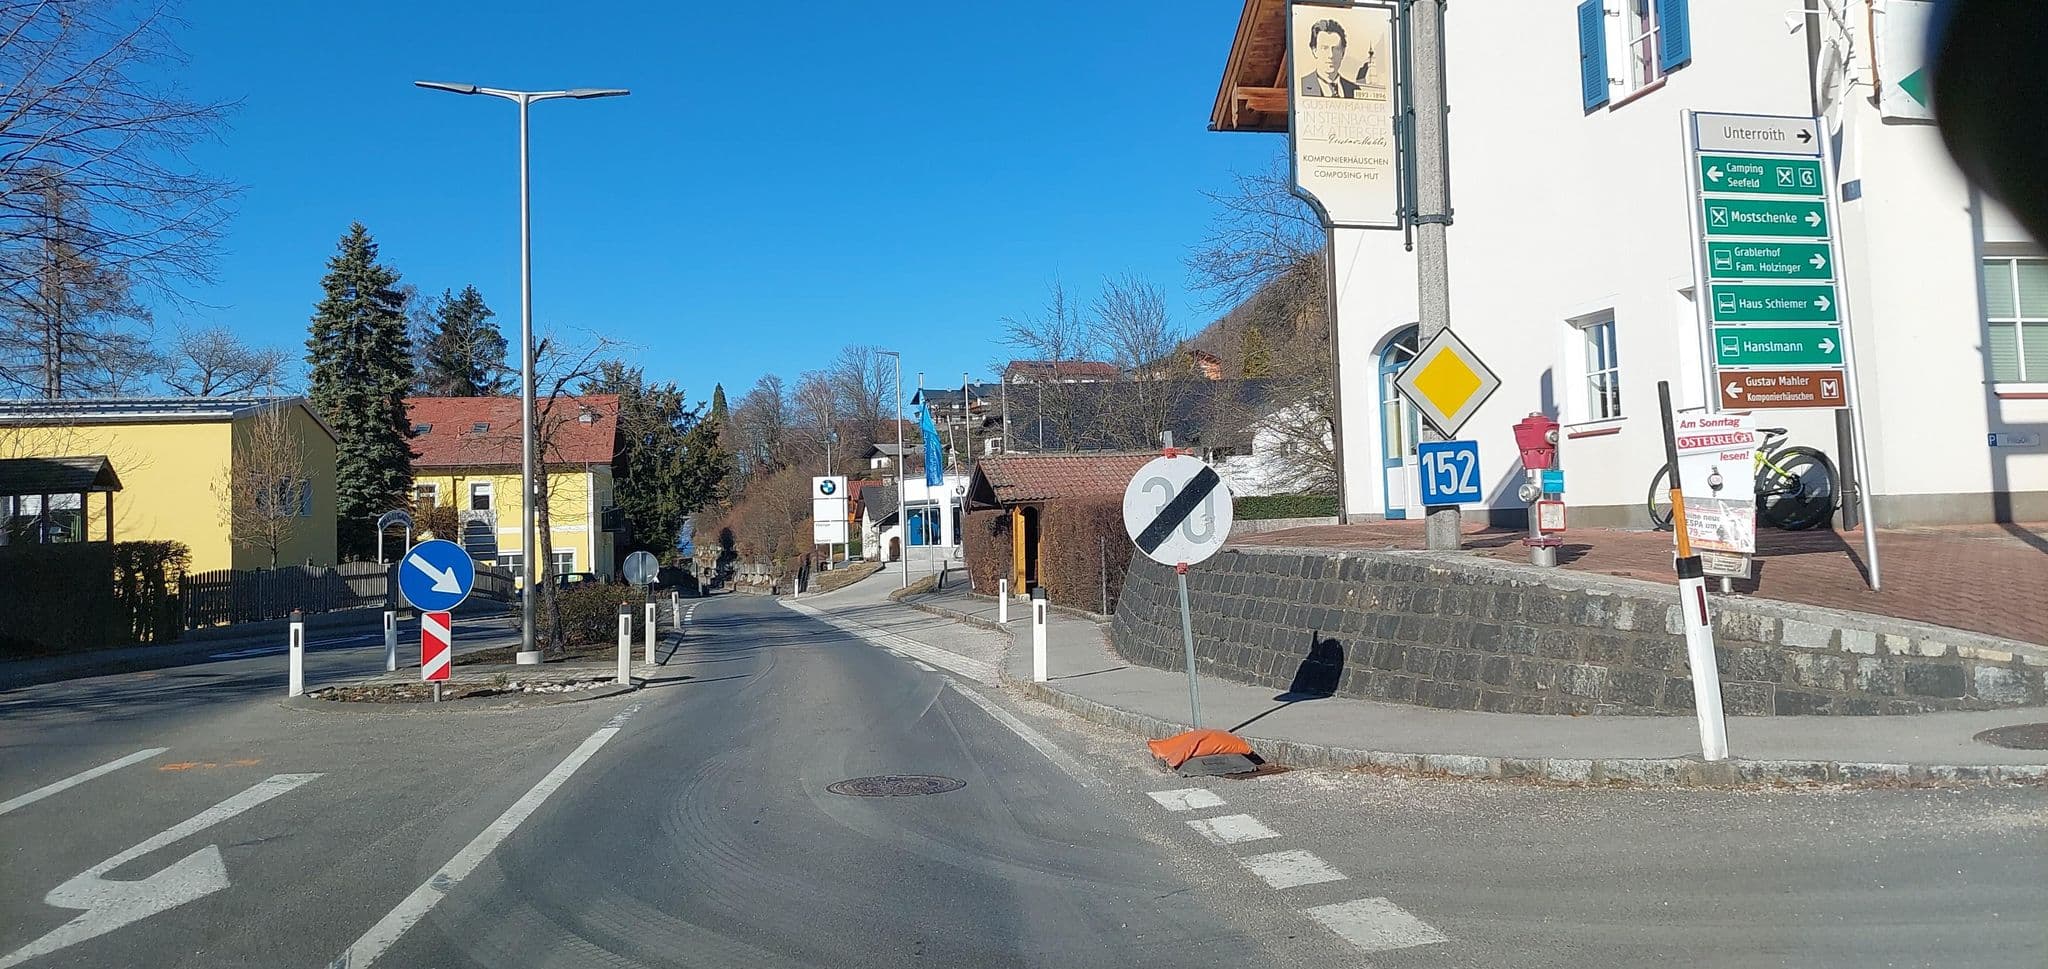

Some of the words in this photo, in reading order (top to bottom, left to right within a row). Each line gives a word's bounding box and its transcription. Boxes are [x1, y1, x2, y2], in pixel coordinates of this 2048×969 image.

[1723, 125, 1786, 141] Unterroith
[1726, 162, 1764, 175] Camping
[1313, 170, 1362, 180] COMPOSING
[1363, 172, 1379, 180] HUT
[1727, 177, 1760, 188] Seefeld
[1731, 210, 1798, 224] Mostschenke
[1734, 246, 1781, 257] Grablerhof
[1735, 262, 1757, 272] Fam.
[1759, 262, 1802, 274] Holzinger
[1739, 299, 1763, 309] Haus
[1765, 298, 1808, 309] Schiemer
[1743, 341, 1804, 352] Hanslmann
[1745, 376, 1777, 387] Gustav
[1778, 376, 1810, 386] Mahler
[1747, 392, 1815, 403] Komponierhäuschen
[1680, 420, 1696, 429] Am
[1699, 417, 1741, 428] Sonntag
[1720, 450, 1750, 461] lesen!
[1422, 450, 1478, 496] 152
